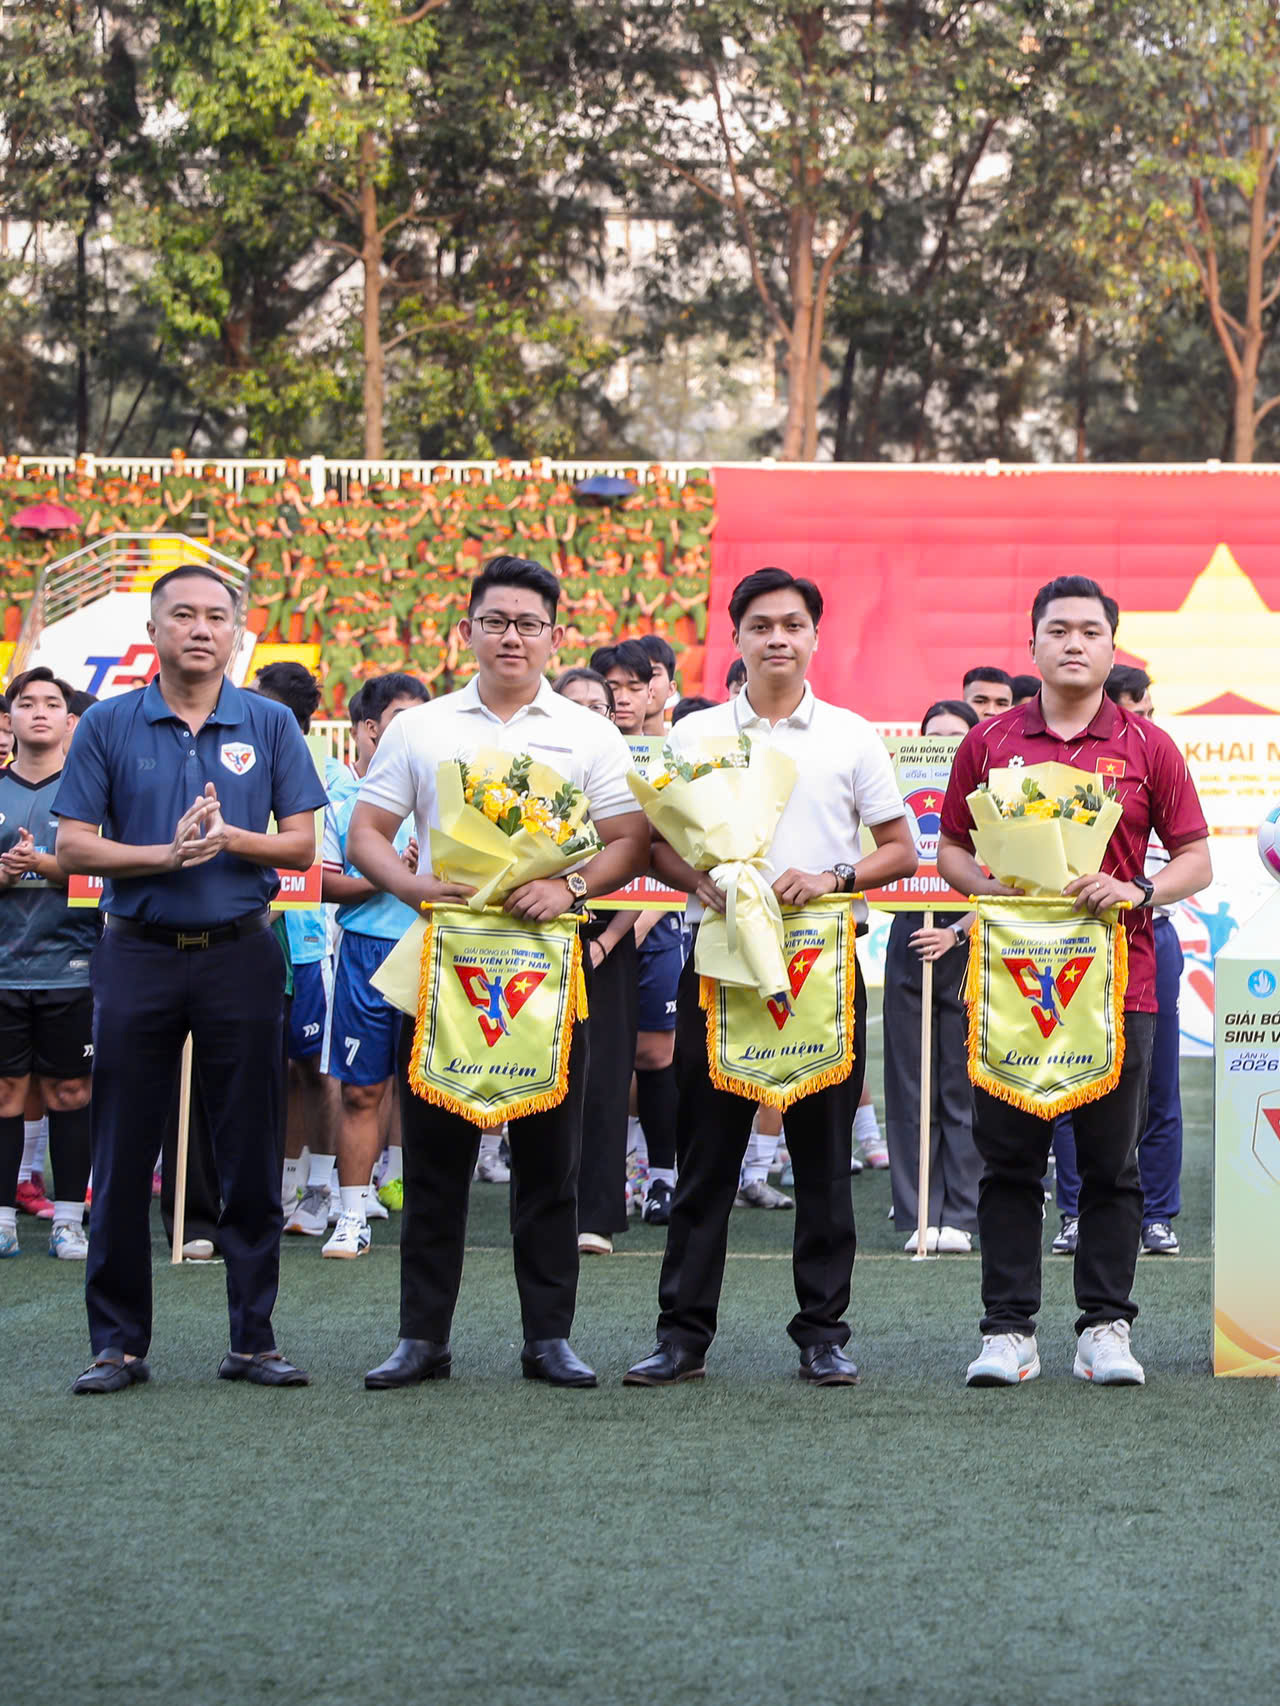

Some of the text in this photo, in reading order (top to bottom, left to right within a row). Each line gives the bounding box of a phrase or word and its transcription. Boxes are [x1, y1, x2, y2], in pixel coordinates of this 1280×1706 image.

[900, 755, 923, 763] SINH
[1185, 742, 1254, 761] KHAI
[280, 876, 305, 891] CM
[1001, 947, 1025, 955] SINH
[1075, 946, 1097, 954] NAM
[453, 955, 477, 964] SINH
[528, 961, 551, 969] NAM
[1224, 1010, 1256, 1025] GIẢI
[1224, 1031, 1266, 1043] SINH
[345, 1036, 361, 1066] 7
[780, 1041, 824, 1058] niệm
[1047, 1051, 1093, 1068] niệm
[1230, 1059, 1279, 1071] 2026
[489, 1061, 537, 1080] niệm
